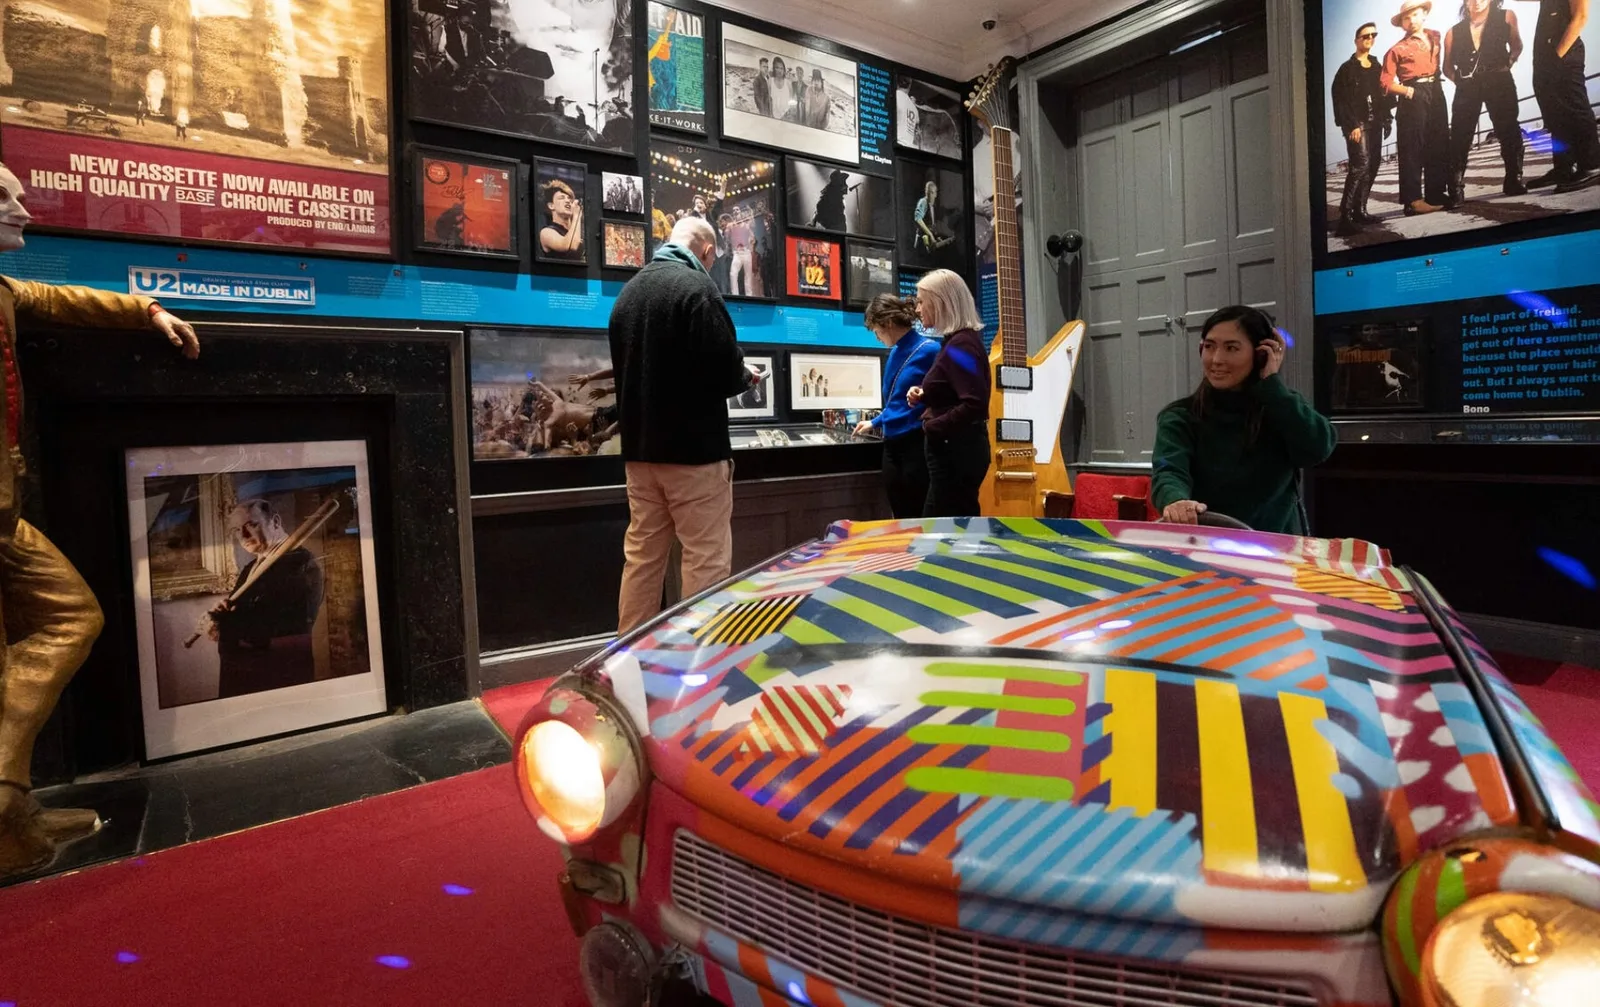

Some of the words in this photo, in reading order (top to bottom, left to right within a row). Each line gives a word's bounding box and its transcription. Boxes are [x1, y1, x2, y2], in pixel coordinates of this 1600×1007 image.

[674, 10, 702, 37] AID
[861, 151, 875, 160] Adam
[875, 155, 892, 165] Clayton
[69, 153, 119, 176] NEW
[123, 160, 218, 188] CASSETTE
[222, 172, 264, 194] NOW
[268, 178, 350, 202] AVAILABLE
[353, 188, 375, 206] ON
[30, 169, 83, 193] HIGH
[89, 176, 170, 202] QUALITY
[175, 189, 215, 204] BASF
[221, 192, 294, 214] CHROME
[298, 200, 375, 223] CASSETTE
[267, 216, 312, 228] PRODUCED
[315, 221, 327, 229] BY
[135, 271, 178, 292] U2
[805, 264, 827, 286] U2
[182, 282, 231, 296] MADE
[233, 285, 250, 297] IN
[253, 287, 308, 300] DUBLIN
[1461, 315, 1467, 324] I
[1469, 313, 1490, 323] feel
[1493, 311, 1516, 323] part
[1518, 309, 1530, 319] of
[1533, 304, 1582, 317] Ireland.
[1462, 328, 1467, 337] I
[1469, 325, 1499, 336] climb
[1501, 325, 1527, 334] over
[1529, 321, 1549, 331] the
[1552, 317, 1577, 329] wall
[1462, 341, 1480, 351] get
[1482, 339, 1500, 348] out
[1502, 337, 1514, 347] of
[1516, 336, 1543, 345] here
[1545, 332, 1600, 343] sometim
[1462, 352, 1506, 362] because
[1508, 350, 1526, 359] the
[1529, 348, 1561, 360] place
[1462, 365, 1491, 375] make
[1493, 364, 1514, 375] you
[1516, 363, 1539, 373] tear
[1542, 362, 1569, 373] your
[1572, 359, 1598, 369] hair
[1463, 379, 1484, 387] out.
[1486, 377, 1506, 386] But
[1508, 376, 1513, 386] I
[1516, 375, 1556, 386] always
[1558, 373, 1589, 383] want
[1463, 392, 1490, 400] come
[1493, 390, 1523, 399] home
[1526, 389, 1539, 398] to
[1541, 387, 1585, 398] Dublin.
[1463, 405, 1490, 414] Bono
